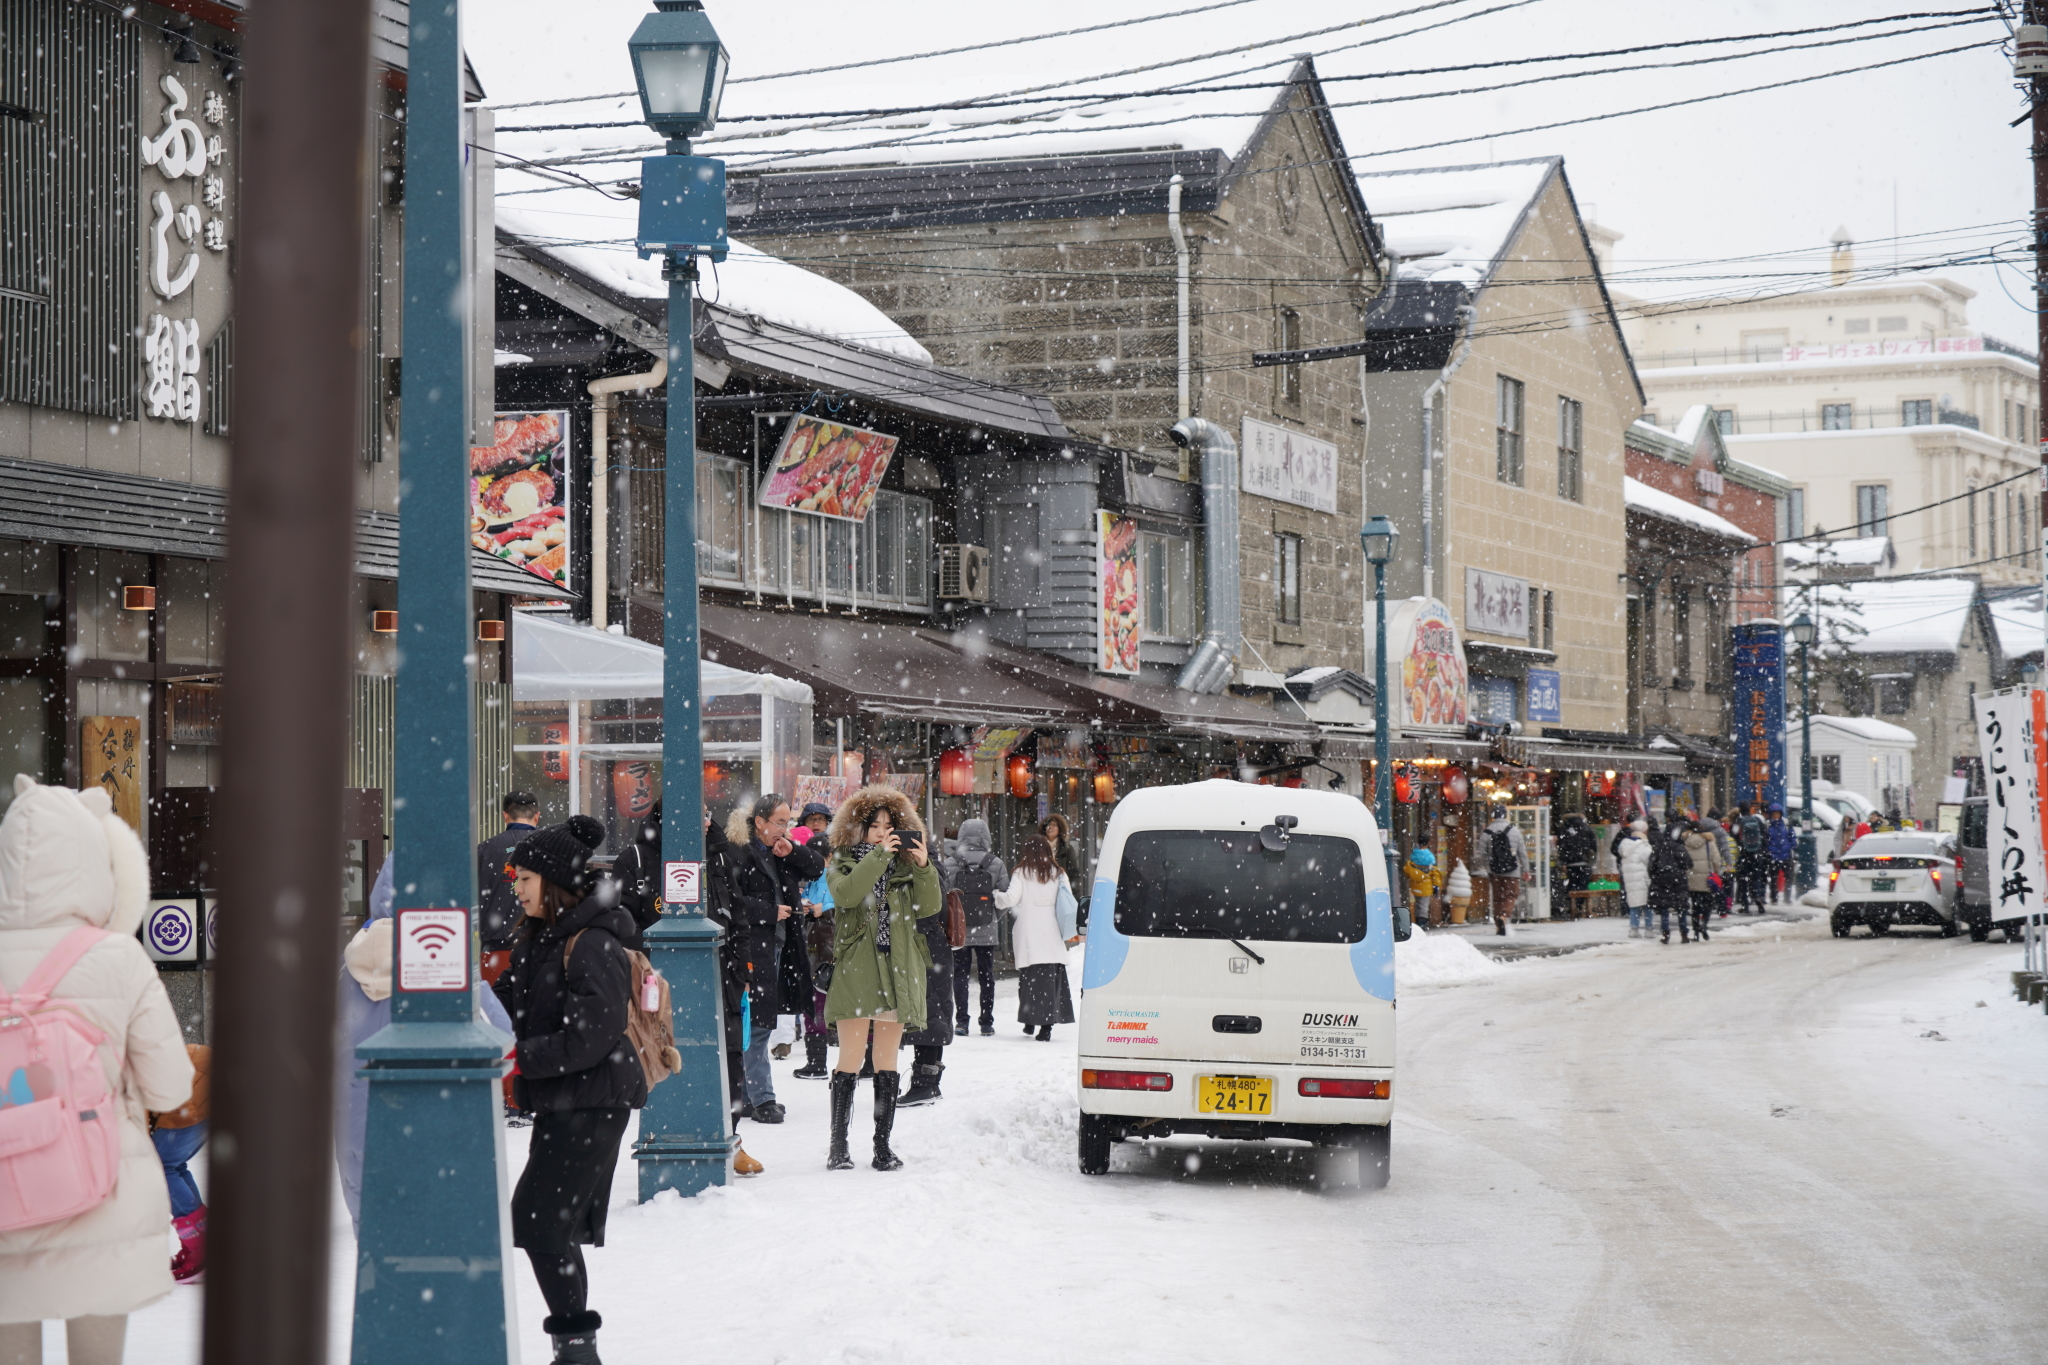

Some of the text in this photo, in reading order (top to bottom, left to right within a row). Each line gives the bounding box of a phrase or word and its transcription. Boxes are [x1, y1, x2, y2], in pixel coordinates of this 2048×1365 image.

[142, 75, 207, 422] ふじ鮨
[627, 762, 651, 813] ラーメン
[1107, 1021, 1149, 1030] TERMINIX
[1107, 1036, 1159, 1045] merry maids
[1300, 1047, 1366, 1059] 0134-51-3131
[1215, 1091, 1268, 1112] 24-17
